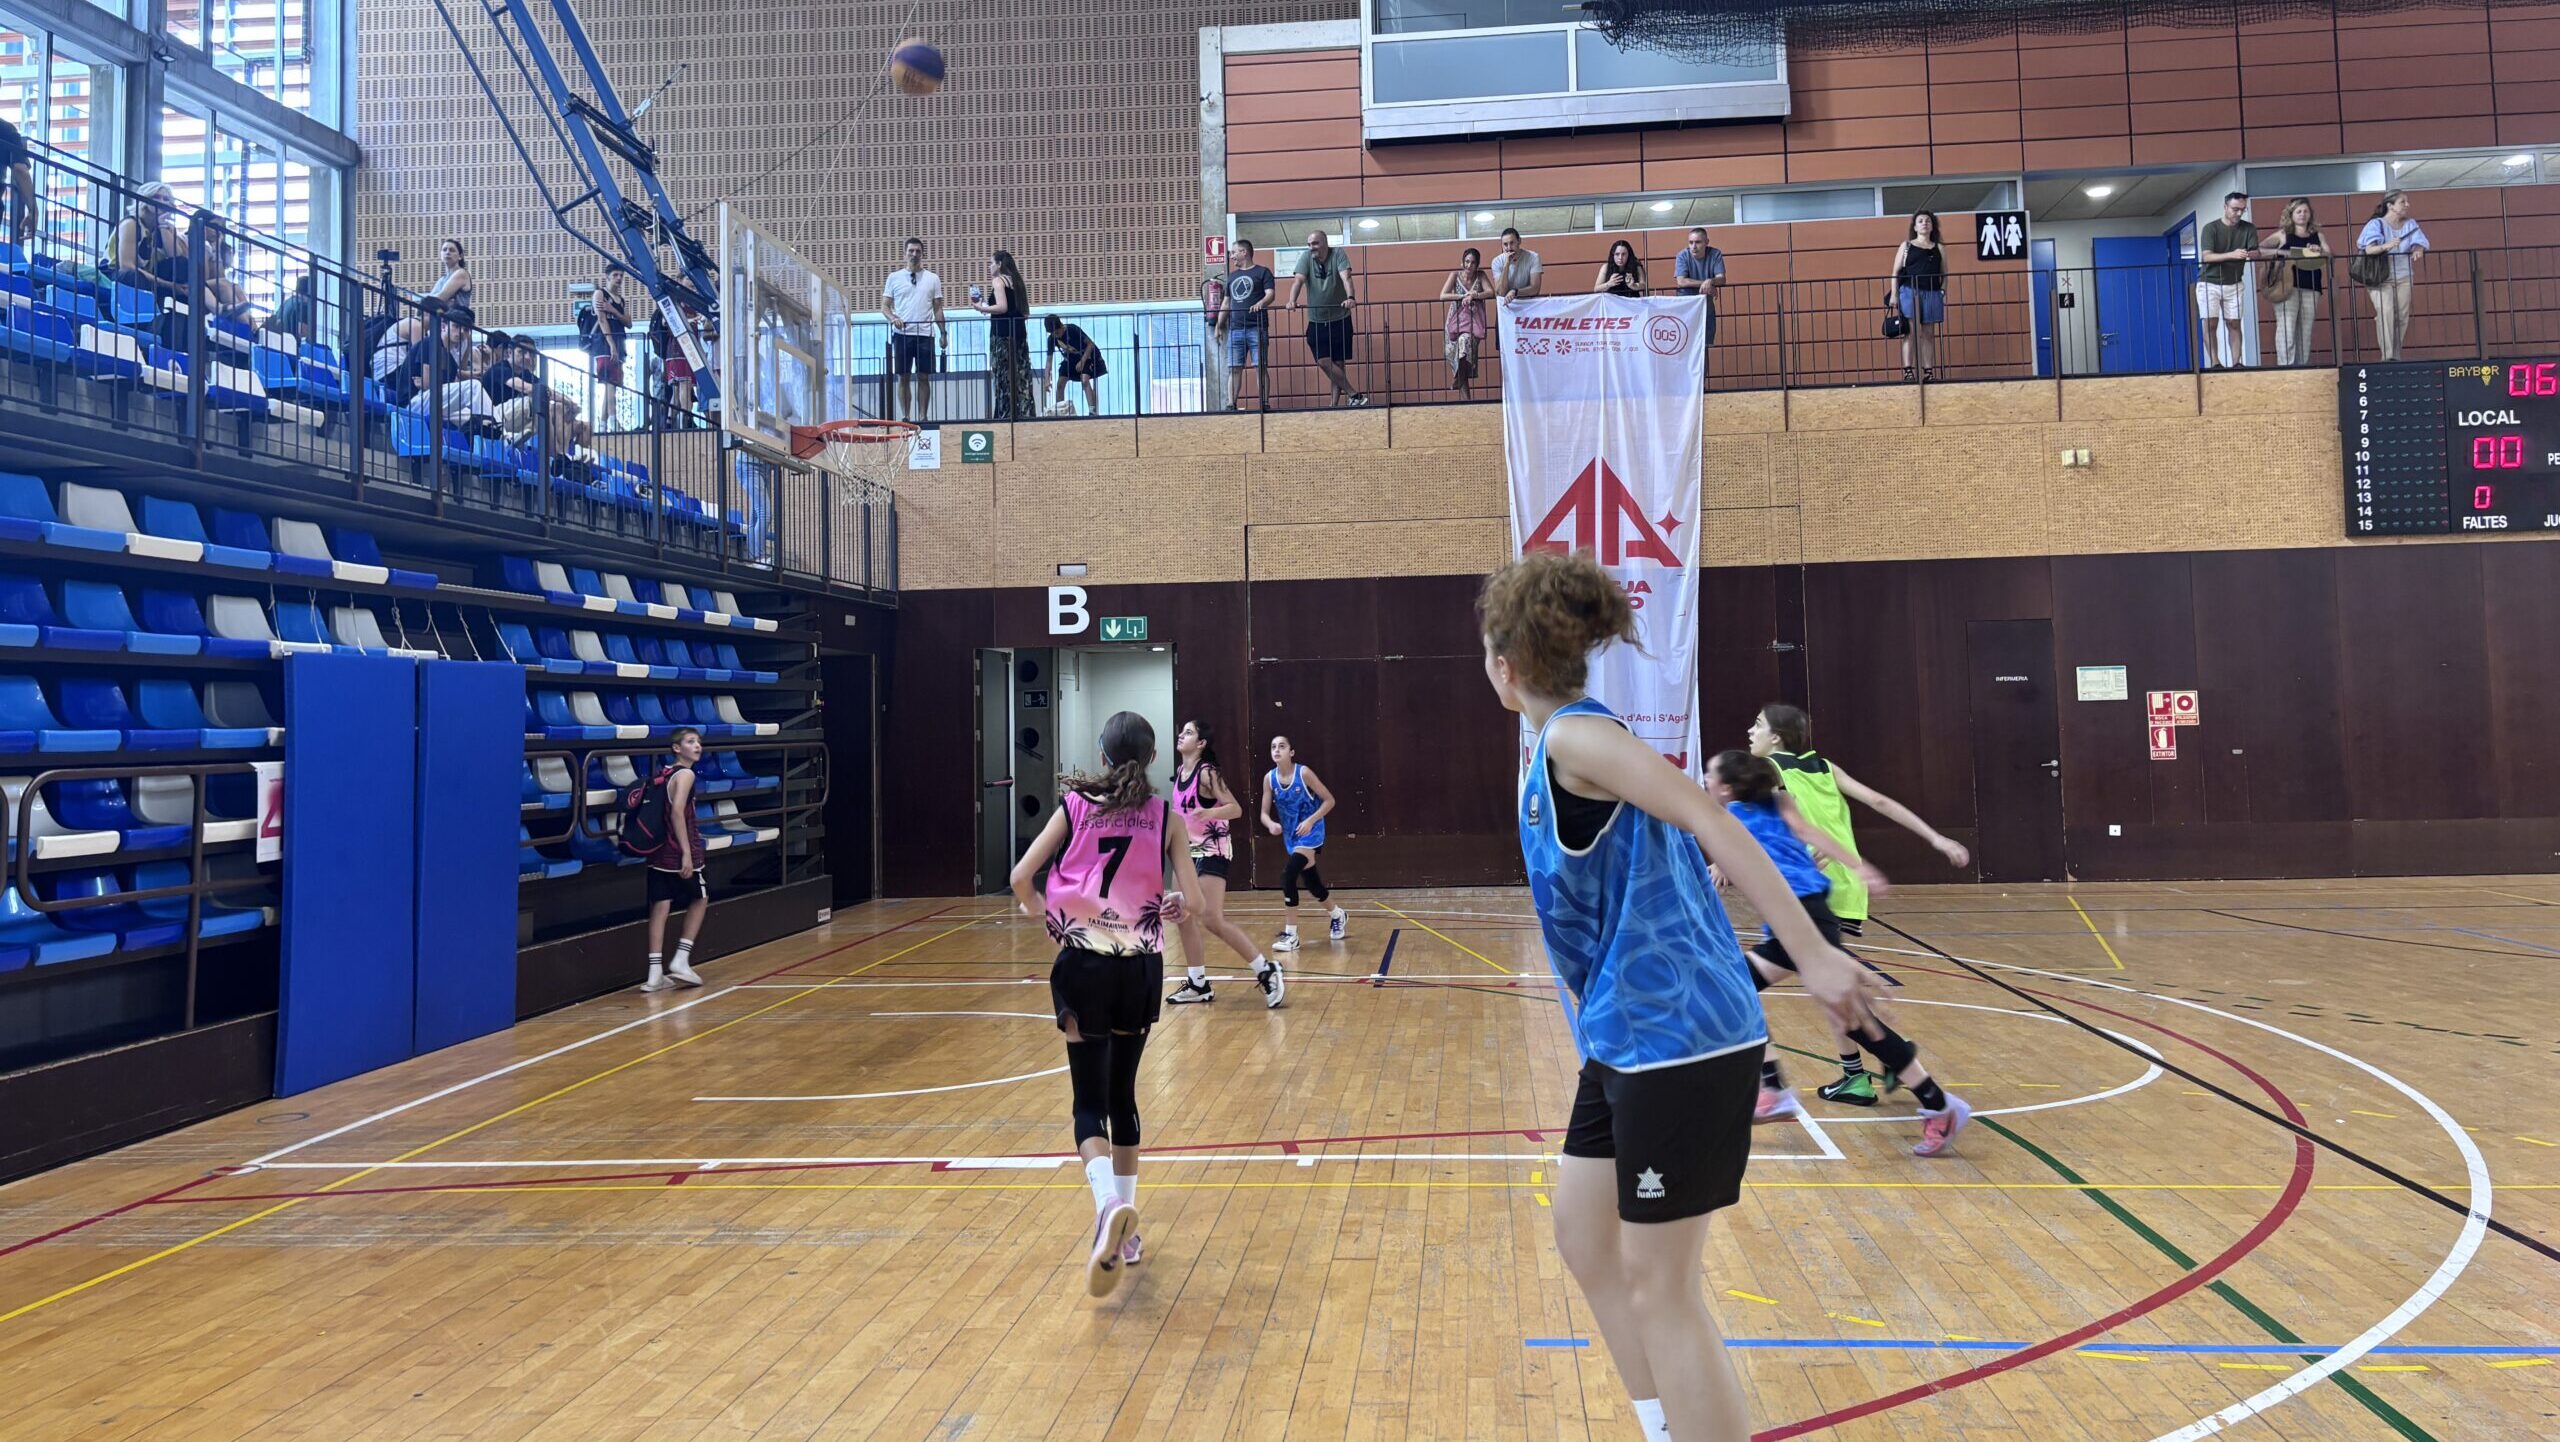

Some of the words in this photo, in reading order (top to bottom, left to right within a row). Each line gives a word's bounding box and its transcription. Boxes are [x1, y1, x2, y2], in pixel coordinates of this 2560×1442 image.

[2358, 369, 2367, 378] 4
[2508, 364, 2557, 396] 06
[2359, 383, 2367, 393] 5
[2359, 396, 2368, 406] 6
[2360, 410, 2368, 420] 7
[2458, 410, 2521, 426] LOCAL
[2360, 424, 2369, 434] 8
[2361, 437, 2370, 447] 9
[2355, 451, 2370, 461] 10
[2473, 436, 2523, 469] 00
[2355, 465, 2369, 475] 11
[2356, 479, 2371, 489] 12
[2356, 492, 2372, 503] 13
[2474, 486, 2491, 509] 0
[2357, 506, 2373, 516] 14
[2358, 520, 2373, 530] 15
[2463, 515, 2508, 529] FALTES
[2544, 514, 2560, 527] JU
[1049, 586, 1090, 634] B
[1181, 794, 1196, 813] 44
[1098, 835, 1133, 899] 7
